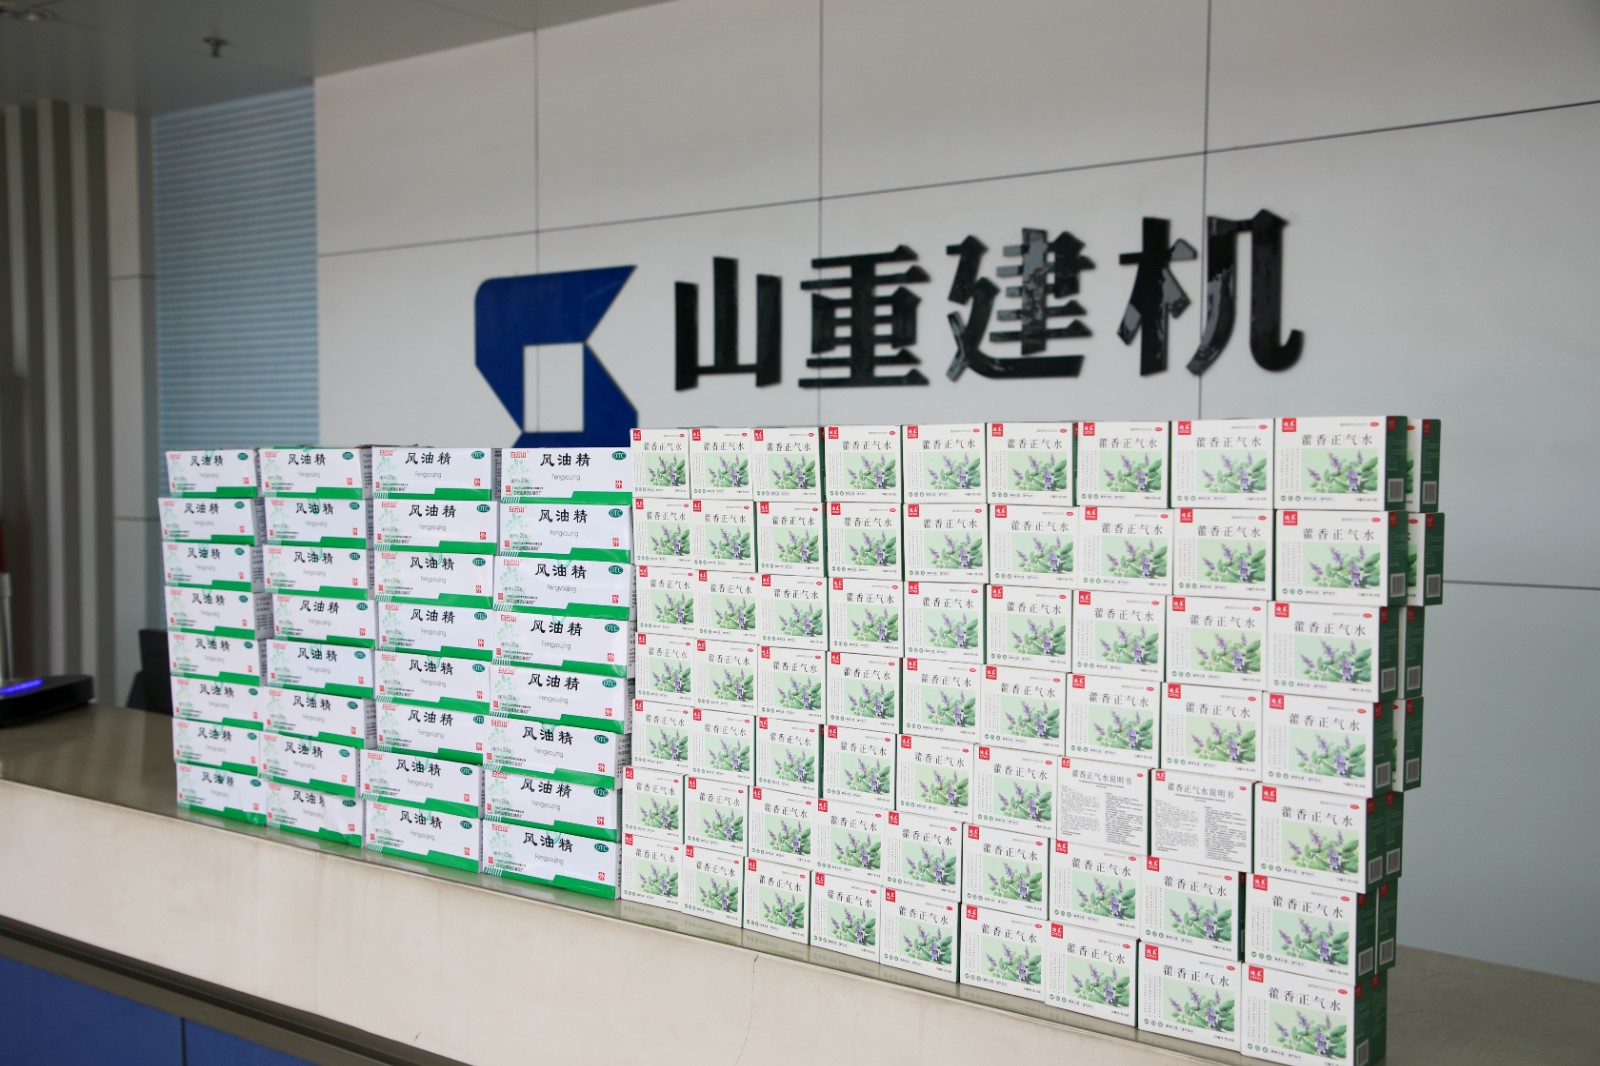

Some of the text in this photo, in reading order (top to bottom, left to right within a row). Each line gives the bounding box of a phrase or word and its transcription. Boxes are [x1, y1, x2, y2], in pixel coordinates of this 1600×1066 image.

[675, 210, 1304, 390] 山重建机
[923, 439, 976, 449] 藿香正气水
[1008, 439, 1062, 449] 藿香正气水
[1100, 438, 1157, 448] 藿香正气水
[1197, 437, 1261, 447] 藿香正气水
[1303, 434, 1372, 445] 藿香正气水
[190, 455, 223, 466] 风油精
[288, 453, 325, 465] 风油精
[405, 452, 451, 465] 风油精
[540, 453, 591, 467] 风油精
[184, 503, 219, 513] 风油精
[296, 503, 334, 514] 风油精
[409, 504, 456, 517] 风油精
[610, 509, 622, 517] OTC
[539, 509, 587, 523] 风油精
[924, 519, 977, 532] 藿香正气水
[1012, 520, 1069, 532] 藿香正气水
[1102, 523, 1163, 535] 藿香正气水
[1198, 526, 1261, 537] 藿香正气水
[1304, 529, 1374, 540] 藿香正气水
[188, 548, 220, 559] 风油精
[294, 552, 333, 564] 风油精
[410, 557, 454, 570] 风油精
[610, 566, 622, 574] OTC
[535, 564, 586, 579] 风油精
[192, 594, 224, 604] 风油精
[923, 597, 973, 608] 藿香正气水
[300, 600, 339, 613] 风油精
[1007, 602, 1061, 614] 藿香正气水
[410, 609, 454, 623] 风油精
[1095, 608, 1154, 621] 藿香正气水
[1191, 615, 1255, 628] 藿香正气水
[530, 620, 582, 636] 风油精
[1295, 621, 1366, 636] 藿香正气水
[196, 639, 229, 650] 风油精
[298, 648, 337, 661] 风油精
[409, 659, 453, 674] 风油精
[528, 673, 580, 690] 风油精
[922, 674, 972, 687] 藿香正气水
[200, 684, 234, 697] 风油精
[1001, 683, 1056, 697] 藿香正气水
[293, 696, 331, 710] 风油精
[1090, 692, 1149, 707] 藿香正气水
[1186, 702, 1250, 718] 藿香正气水
[408, 710, 453, 726] 风油精
[1290, 714, 1360, 731] 藿香正气水
[198, 728, 231, 741] 风油精
[523, 727, 573, 745] 风油精
[285, 742, 323, 758] 风油精
[915, 752, 965, 767] 藿香正气水
[396, 759, 441, 776] 风油精
[994, 764, 1048, 780] 藿香正气水
[202, 772, 233, 786] 风油精
[520, 778, 572, 798] 风油精
[595, 789, 607, 797] OTC
[400, 810, 442, 829] 风油精
[1282, 807, 1353, 826] 藿香正气水
[523, 832, 573, 852] 风油精
[903, 829, 953, 845] 藿香正气水
[595, 844, 608, 852] OTC
[984, 843, 1038, 861] 藿香正气水
[1073, 858, 1131, 877] 藿香正气水
[1164, 876, 1228, 897] 藿香正气水
[1273, 896, 1343, 918] 藿香正气水
[899, 906, 949, 925] 藿香正气水
[982, 924, 1037, 943] 藿香正气水
[1068, 943, 1125, 964] 藿香正气水
[1164, 965, 1229, 987] 藿香正气水
[1269, 987, 1341, 1011] 藿香正气水
